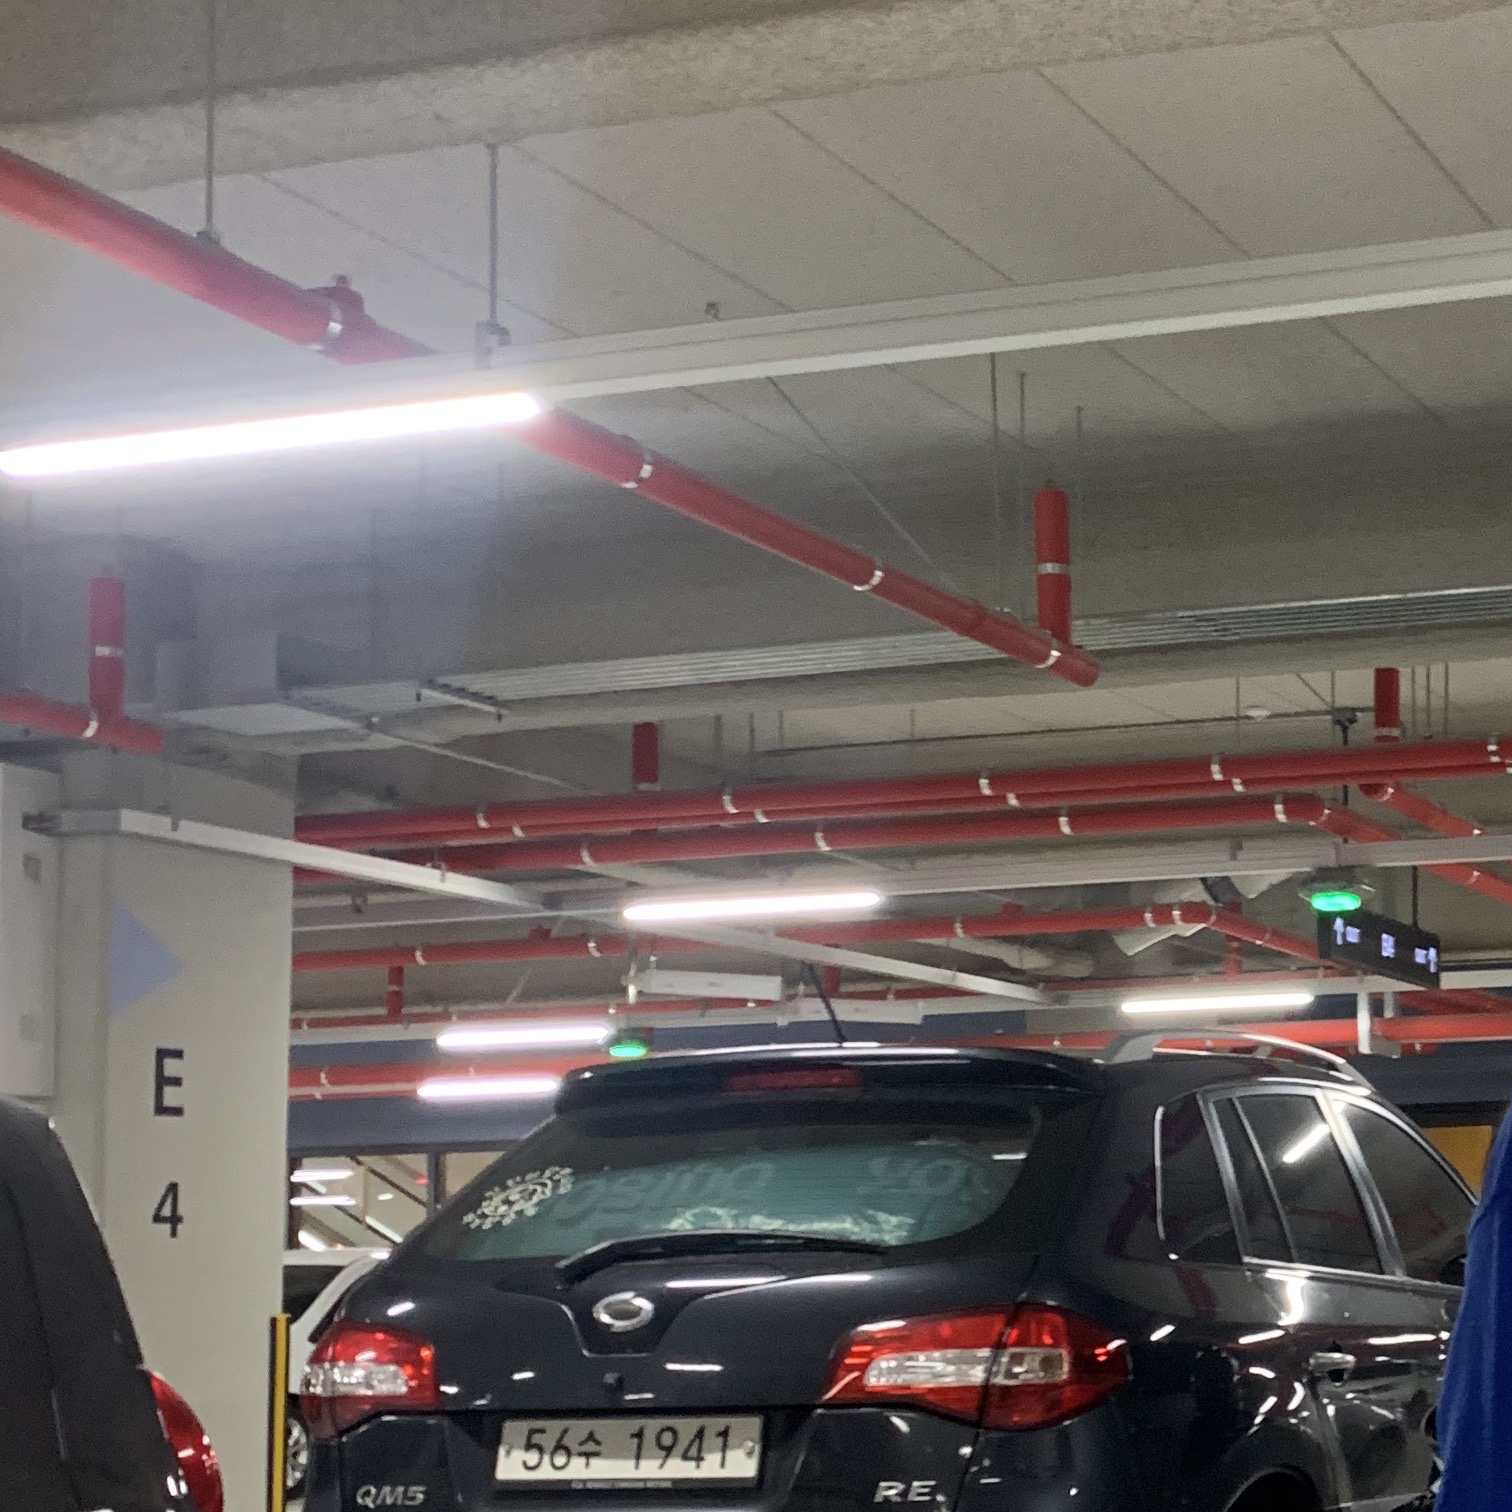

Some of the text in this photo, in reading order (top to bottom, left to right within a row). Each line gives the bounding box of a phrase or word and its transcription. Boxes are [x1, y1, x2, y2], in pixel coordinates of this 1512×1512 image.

[154, 1047, 185, 1117] E
[152, 1179, 184, 1238] 4
[522, 1424, 731, 1471] 56수 1941
[356, 1484, 427, 1509] QM5
